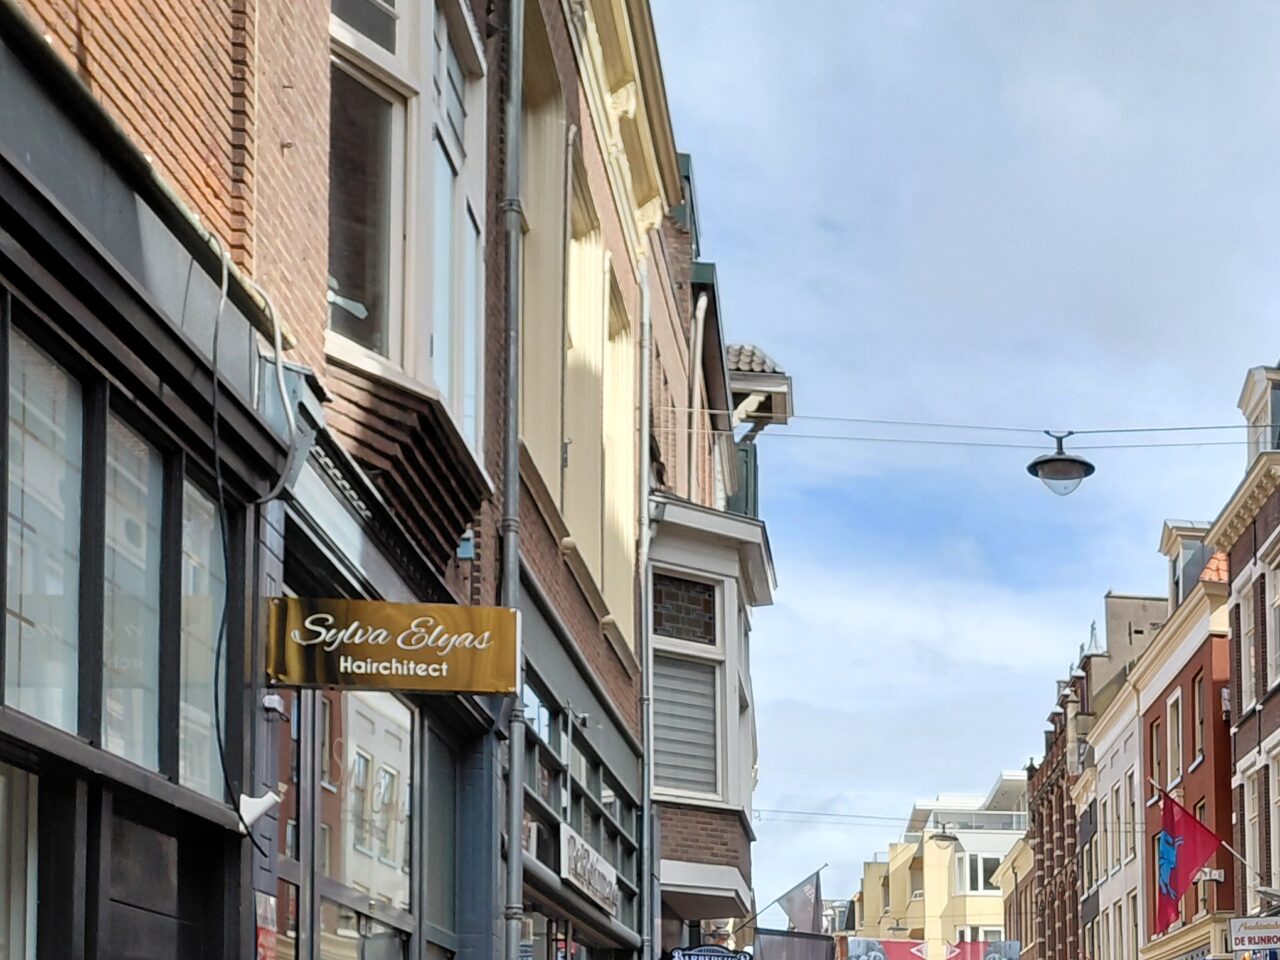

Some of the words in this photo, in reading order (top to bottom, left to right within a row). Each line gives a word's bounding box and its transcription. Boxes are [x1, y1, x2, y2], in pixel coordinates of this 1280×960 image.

[291, 613, 390, 651] Sylva
[396, 617, 494, 656] Elyas
[339, 655, 449, 677] Hairchitect
[1235, 936, 1246, 946] DE
